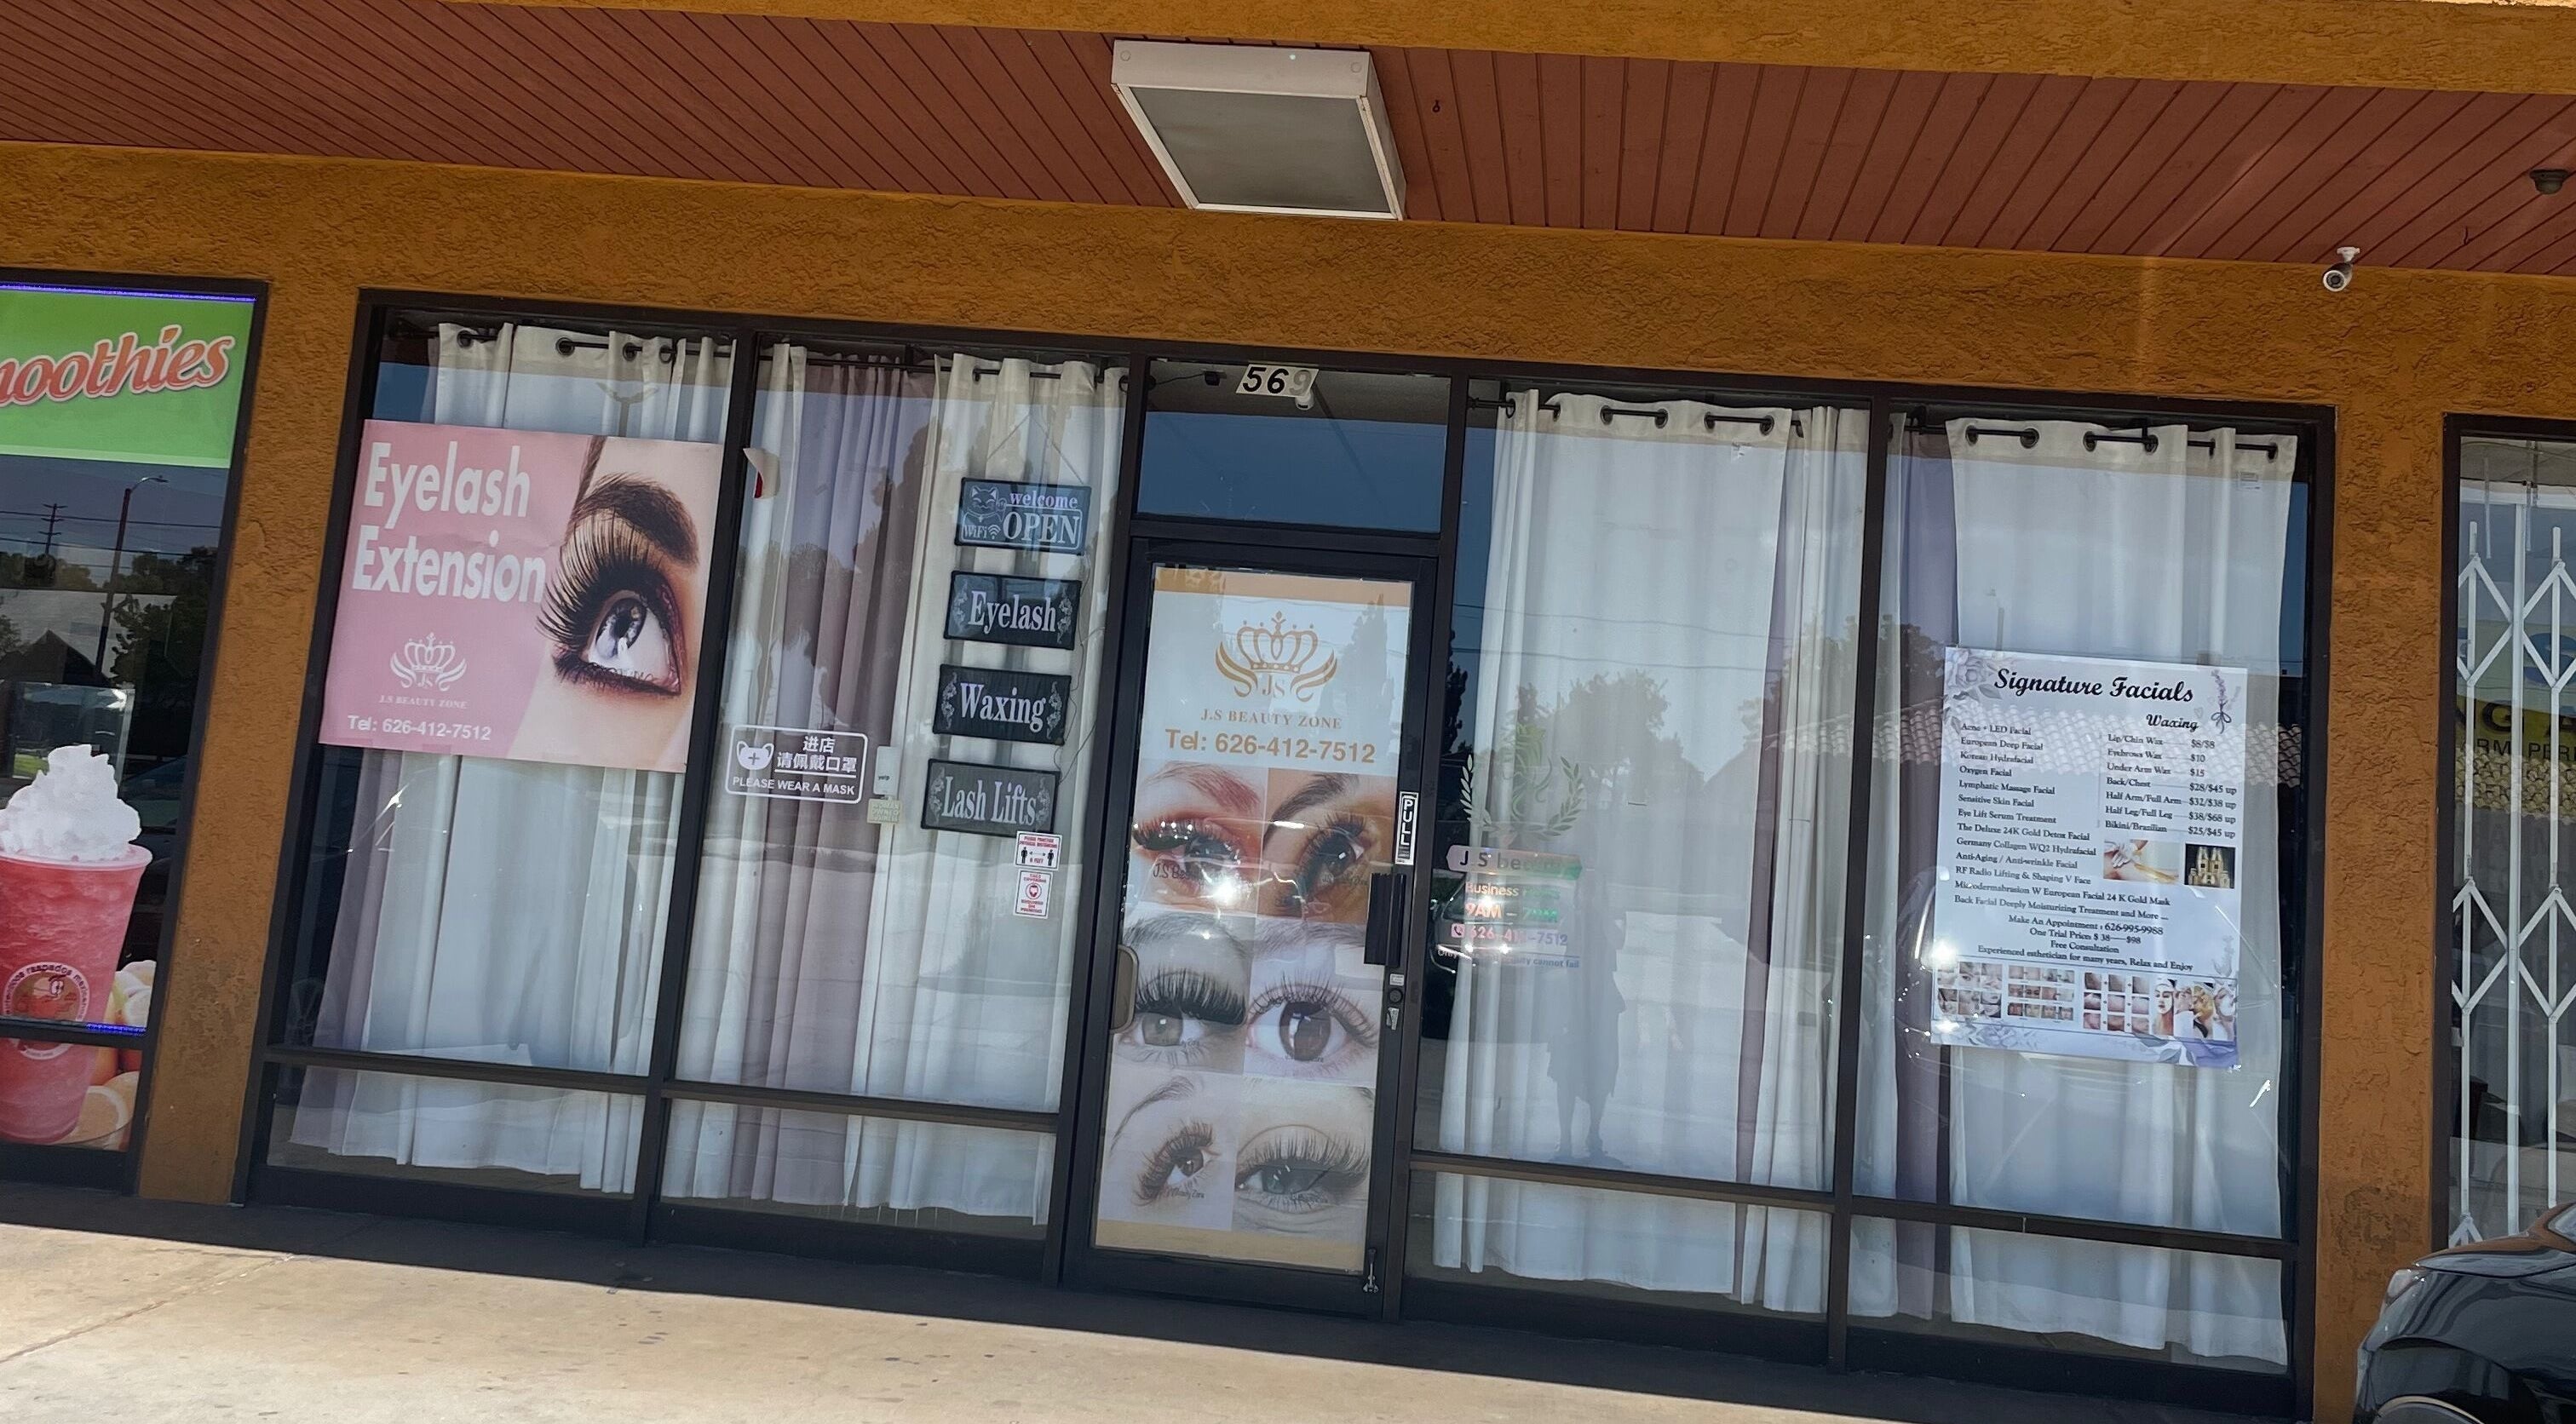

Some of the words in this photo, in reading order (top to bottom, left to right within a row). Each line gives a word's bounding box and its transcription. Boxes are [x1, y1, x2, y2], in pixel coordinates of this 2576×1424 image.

[1242, 366, 1313, 396] 569
[364, 439, 531, 530] Eyelash
[1009, 490, 1078, 509] welcome
[963, 524, 987, 539] WiFi
[1003, 511, 1080, 545] OPEN
[352, 524, 547, 603] Extension
[968, 589, 1057, 634] Eyelash
[1994, 668, 2103, 697] Signature
[2109, 676, 2194, 703] Facials
[395, 697, 435, 708] BEAUTY
[438, 699, 469, 709] ZONE
[960, 682, 1047, 733] Waxing
[348, 715, 377, 732] Tel:
[382, 718, 492, 741] 626-412-7512
[1200, 708, 1222, 721] J.S
[1228, 710, 1293, 726] BEAUTY
[1297, 715, 1343, 730] ZONE
[2146, 714, 2199, 732] Waxing
[1990, 725, 2008, 733] LED
[2010, 726, 2032, 735] Facial
[802, 736, 836, 754] 进店
[1164, 728, 1207, 751] Tel:
[1215, 732, 1376, 764] 626-412-7512
[1961, 737, 1998, 747] European
[1999, 740, 2020, 749] Deep
[2021, 742, 2044, 750] Facial
[2107, 734, 2143, 744] Lip/Chin
[2146, 737, 2164, 745] Wax
[776, 752, 858, 773] 请佩戴口罩
[1960, 751, 1987, 760] Korean
[1990, 754, 2033, 764] Hydrafacial
[2145, 751, 2162, 760] Wax
[2191, 754, 2205, 762] $10
[1959, 766, 1987, 776] Oxygen
[1990, 767, 2012, 777] Facial
[2107, 762, 2133, 772] Under
[2134, 765, 2152, 773] Arm
[2154, 767, 2171, 775] Wax
[2190, 768, 2205, 778] $15
[732, 776, 775, 790] PLEASE
[777, 779, 810, 792] WEAR
[812, 782, 820, 792] A
[823, 784, 856, 795] MASK
[1959, 779, 1999, 790] Lymphatic
[2001, 783, 2031, 792] Massage
[2033, 785, 2056, 795] Facial
[2106, 777, 2151, 788] Back/Chest
[2189, 783, 2223, 793] $28/$45
[2225, 787, 2237, 795] up
[941, 776, 986, 821] Lash
[991, 781, 1037, 826] Lifts
[1958, 794, 1991, 804] Sensitive
[1992, 796, 2010, 806] Skin
[2012, 799, 2034, 807] Facial
[2106, 791, 2123, 800] Half
[2125, 793, 2162, 803] Arm/Full
[2188, 797, 2223, 807] $32/$38
[2225, 801, 2237, 810] up
[1400, 799, 1414, 846] PULL
[1958, 808, 1971, 818] Eye
[1973, 809, 1987, 818] Lift
[1989, 812, 2014, 820] Serum
[2016, 812, 2056, 824] Treatment
[2105, 805, 2123, 813] Half
[2125, 807, 2156, 817] Leg/Full
[2159, 810, 2173, 819] Leg
[2224, 817, 2236, 825] up
[1957, 823, 1973, 831] The
[1975, 824, 2001, 833] Deluxe
[2003, 827, 2020, 835] 24K
[2021, 828, 2041, 837] Gold
[2044, 830, 2066, 839] Detox
[2067, 831, 2090, 841] Facial
[2105, 820, 2167, 832] Bikini/Brazilian
[2188, 826, 2222, 836] $25/$45
[2224, 831, 2236, 840] up
[1957, 837, 1992, 847] Germany
[1993, 840, 2027, 850] Collagen
[2029, 842, 2050, 853] WQ2
[2052, 845, 2096, 856] Hydrafacial
[1955, 852, 1998, 864] Anti-Aging
[2005, 855, 2054, 867] Anti-wrinkle
[2056, 859, 2078, 869] Facial
[1955, 865, 1967, 875] RF
[1969, 867, 1992, 876] Radio
[1993, 869, 2020, 879] Lifting
[2032, 872, 2064, 883] Shaping
[2073, 876, 2091, 884] Face
[1465, 881, 1519, 896] Business
[2044, 888, 2080, 899] European
[2083, 891, 2105, 900] Facial
[2128, 894, 2148, 904] Gold
[2149, 897, 2171, 906] Mask
[1954, 895, 1974, 904] Back
[1975, 897, 1997, 905] Facial
[1999, 899, 2027, 910] Deeply
[2028, 901, 2077, 913] Moisturizing
[2079, 905, 2119, 916] Treatment
[2137, 910, 2159, 920] More
[2009, 915, 2029, 924] Make
[2032, 917, 2044, 926] An
[2045, 918, 2098, 930] Appointment
[2030, 927, 2046, 936] One
[2048, 929, 2067, 938] Trial
[2050, 940, 2067, 949] Free
[2068, 942, 2119, 953] Consultation
[1978, 945, 2025, 956] Experienced
[2083, 956, 2104, 965] many
[2130, 958, 2151, 967] Relax
[2171, 962, 2194, 972] Enjoy
